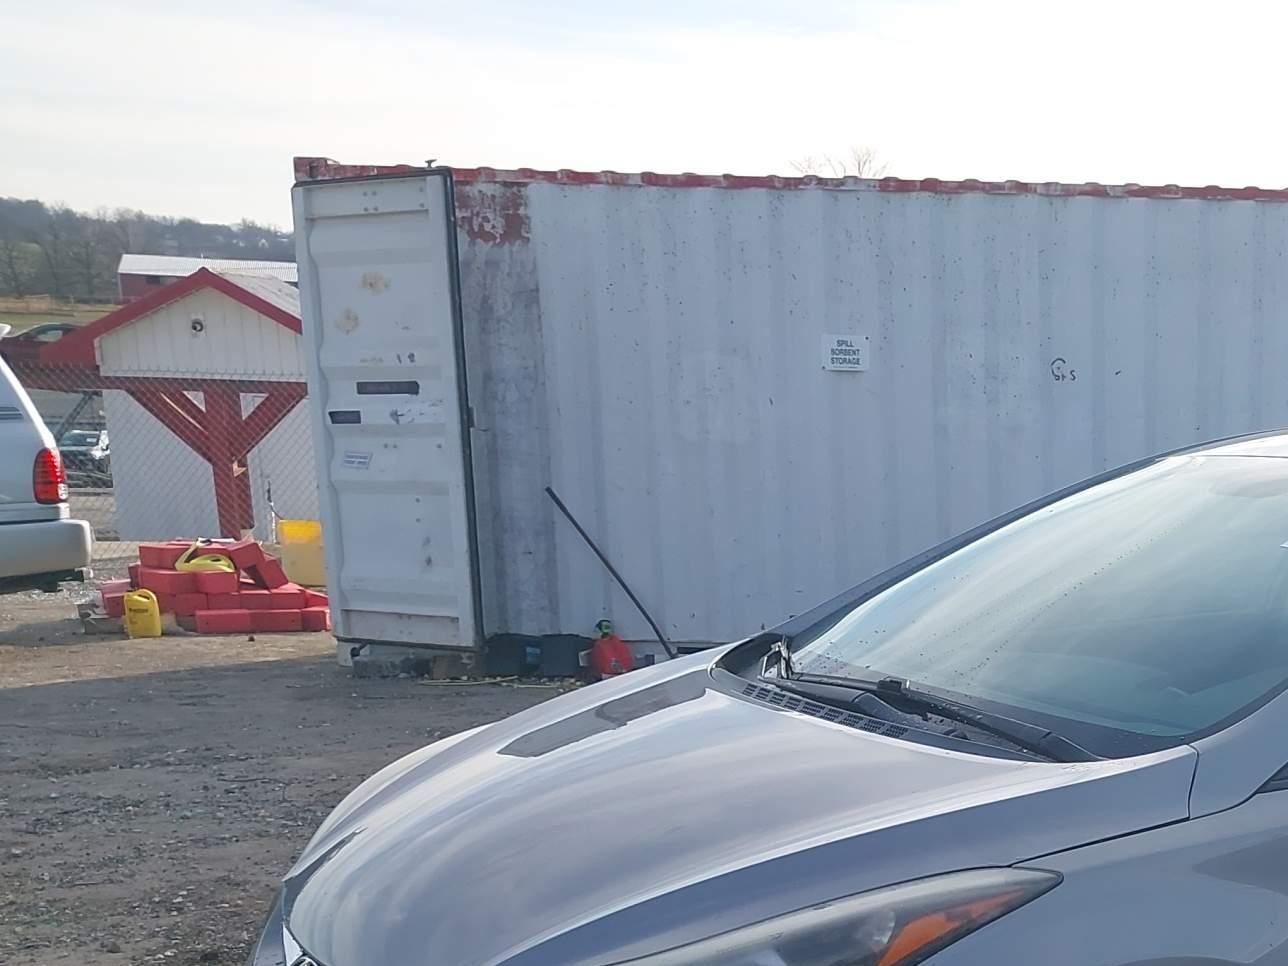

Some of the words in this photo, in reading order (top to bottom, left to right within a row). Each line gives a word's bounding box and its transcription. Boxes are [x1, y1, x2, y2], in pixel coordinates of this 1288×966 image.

[836, 339, 855, 348] SPILL
[830, 348, 860, 356] SORBENT
[830, 357, 861, 366] STORAGE
